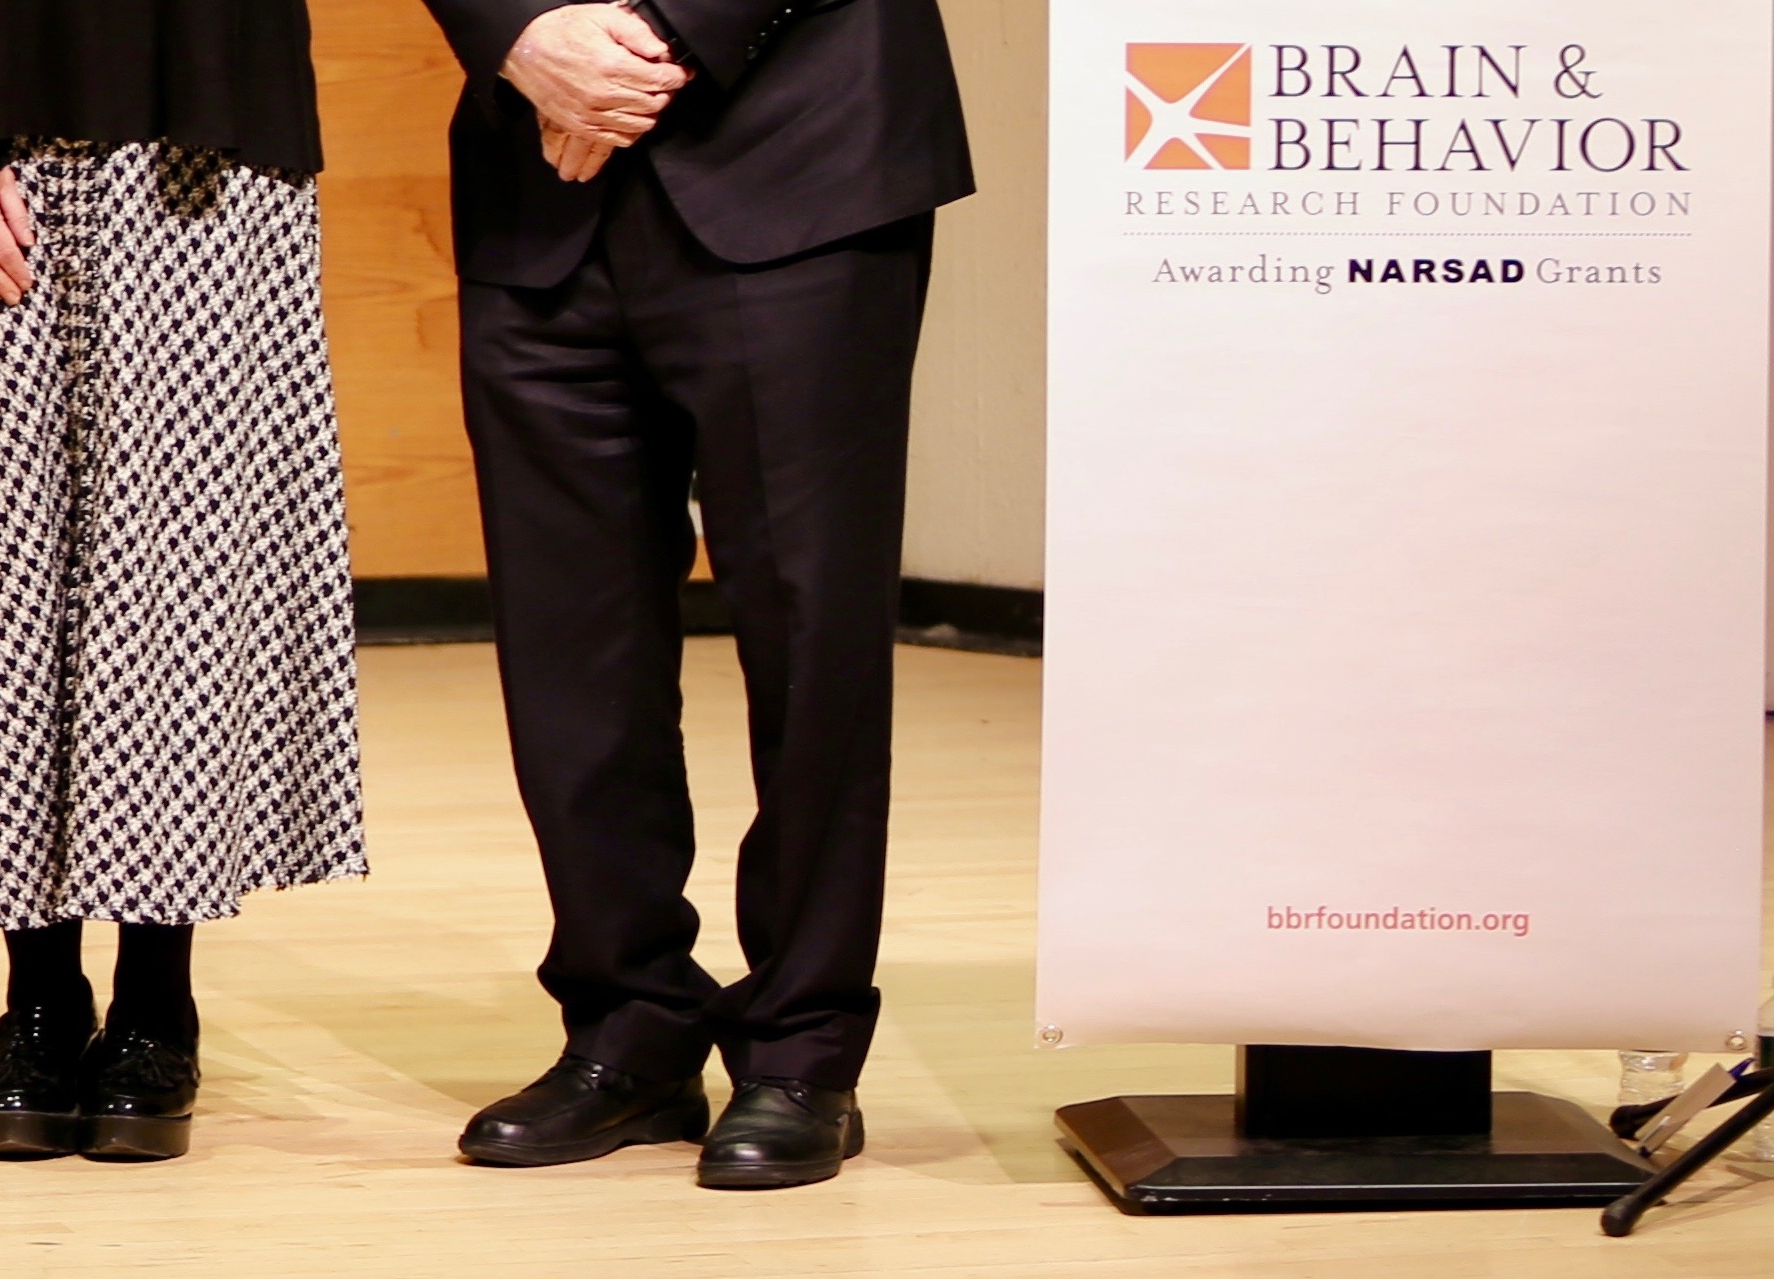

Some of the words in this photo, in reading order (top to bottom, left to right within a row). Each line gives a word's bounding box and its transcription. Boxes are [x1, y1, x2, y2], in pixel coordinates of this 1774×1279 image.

[1268, 44, 1528, 99] BRAIN
[1553, 44, 1604, 99] &
[1267, 117, 1692, 173] BEHAVIOR
[1124, 191, 1361, 217] RESEARCH
[1387, 191, 1692, 217] FOUNDATION
[1152, 254, 1335, 295] Awarding
[1347, 258, 1525, 284] NARSAD
[1536, 258, 1662, 285] Grants
[1267, 905, 1531, 937] bbrfoundation.org
